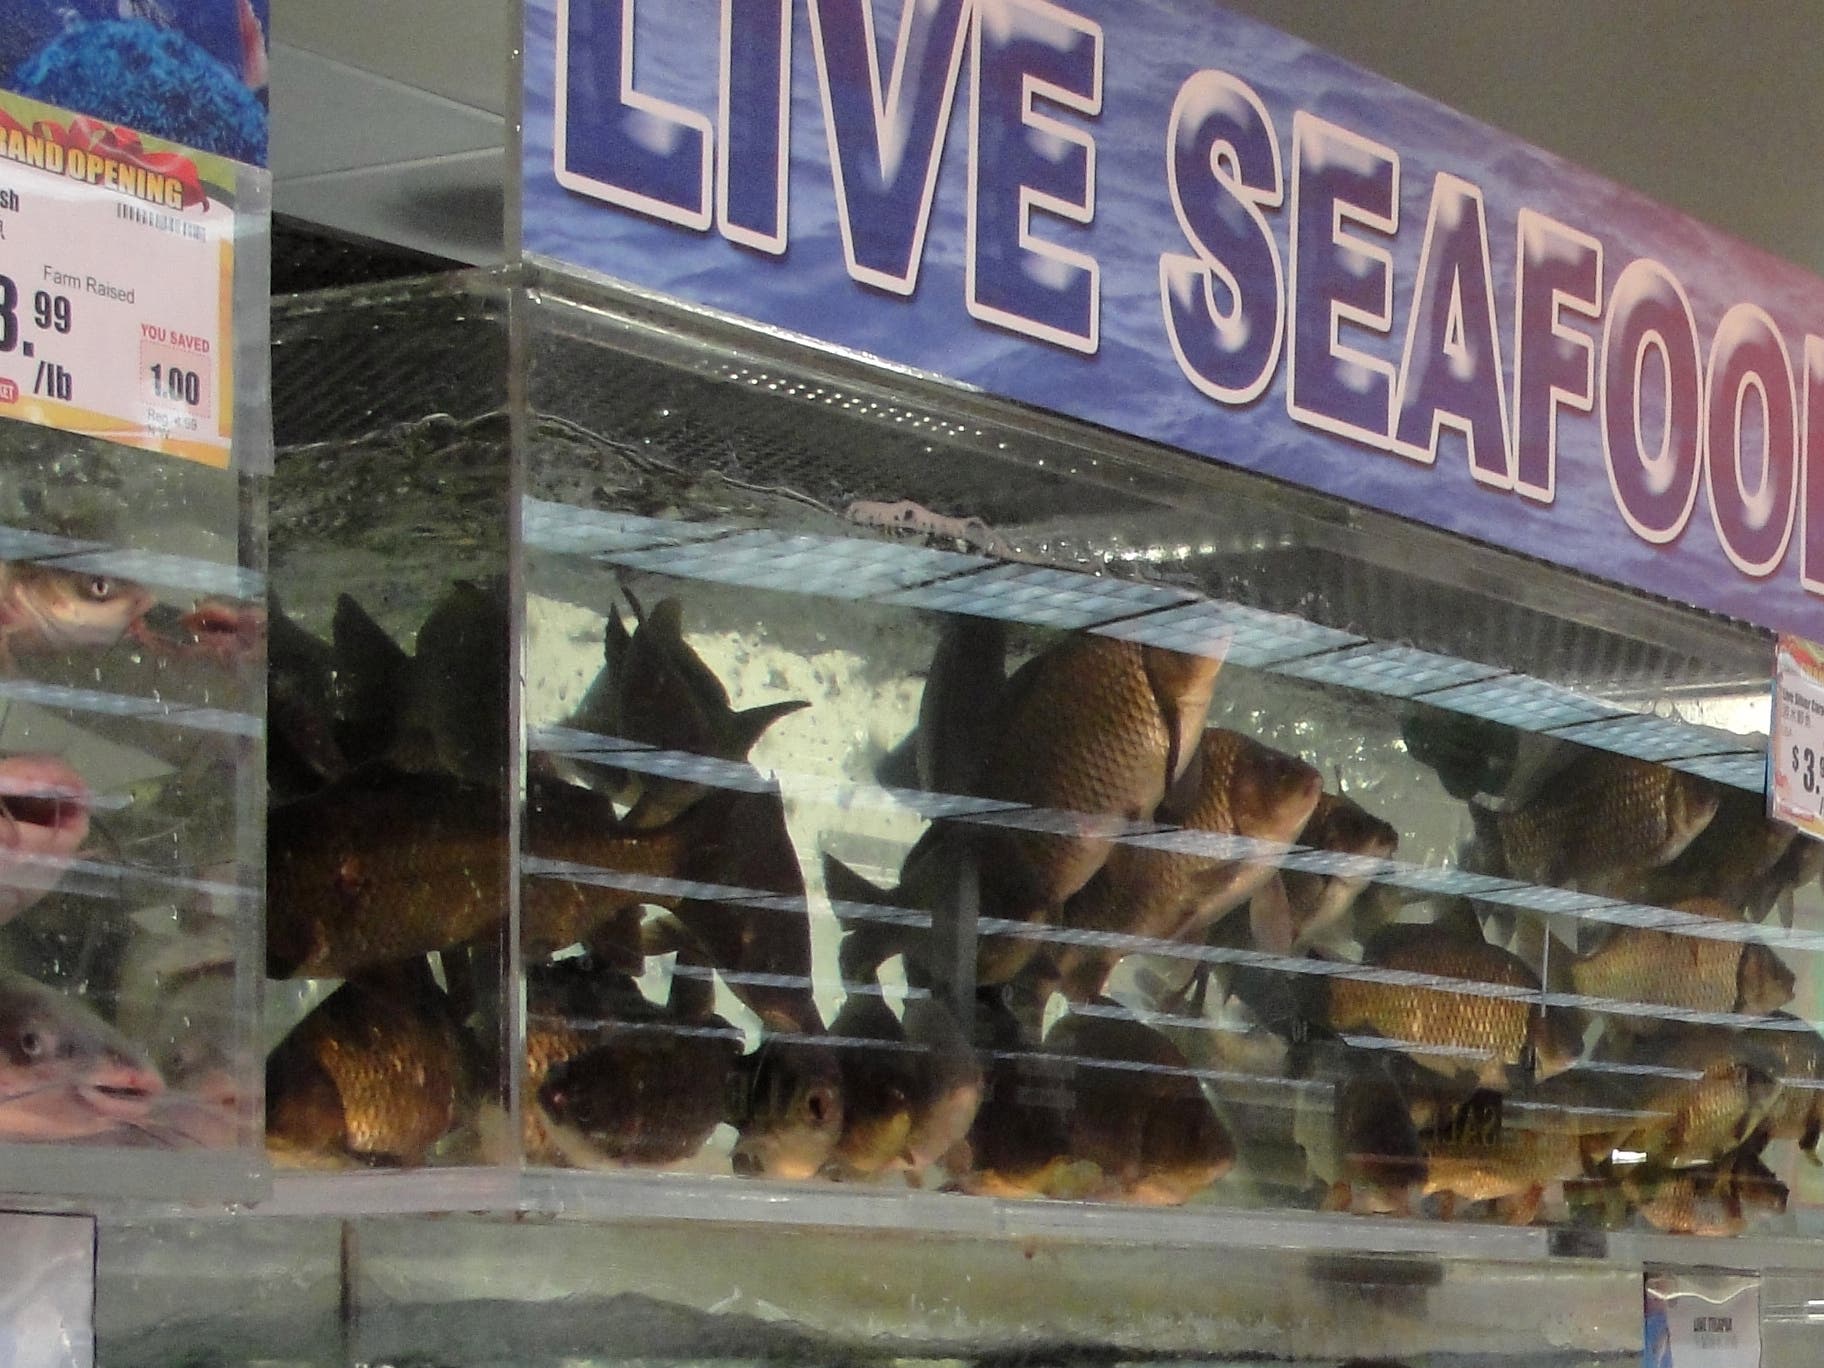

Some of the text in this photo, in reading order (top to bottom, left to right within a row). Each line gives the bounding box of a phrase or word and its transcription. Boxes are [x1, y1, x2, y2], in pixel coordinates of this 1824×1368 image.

[67, 147, 184, 211] OPENING
[555, 0, 1104, 355] LIVE
[44, 264, 136, 304] Farm Raised
[140, 322, 210, 354] YOU SAVED
[33, 360, 73, 402] /lb
[150, 362, 200, 407] 1.00
